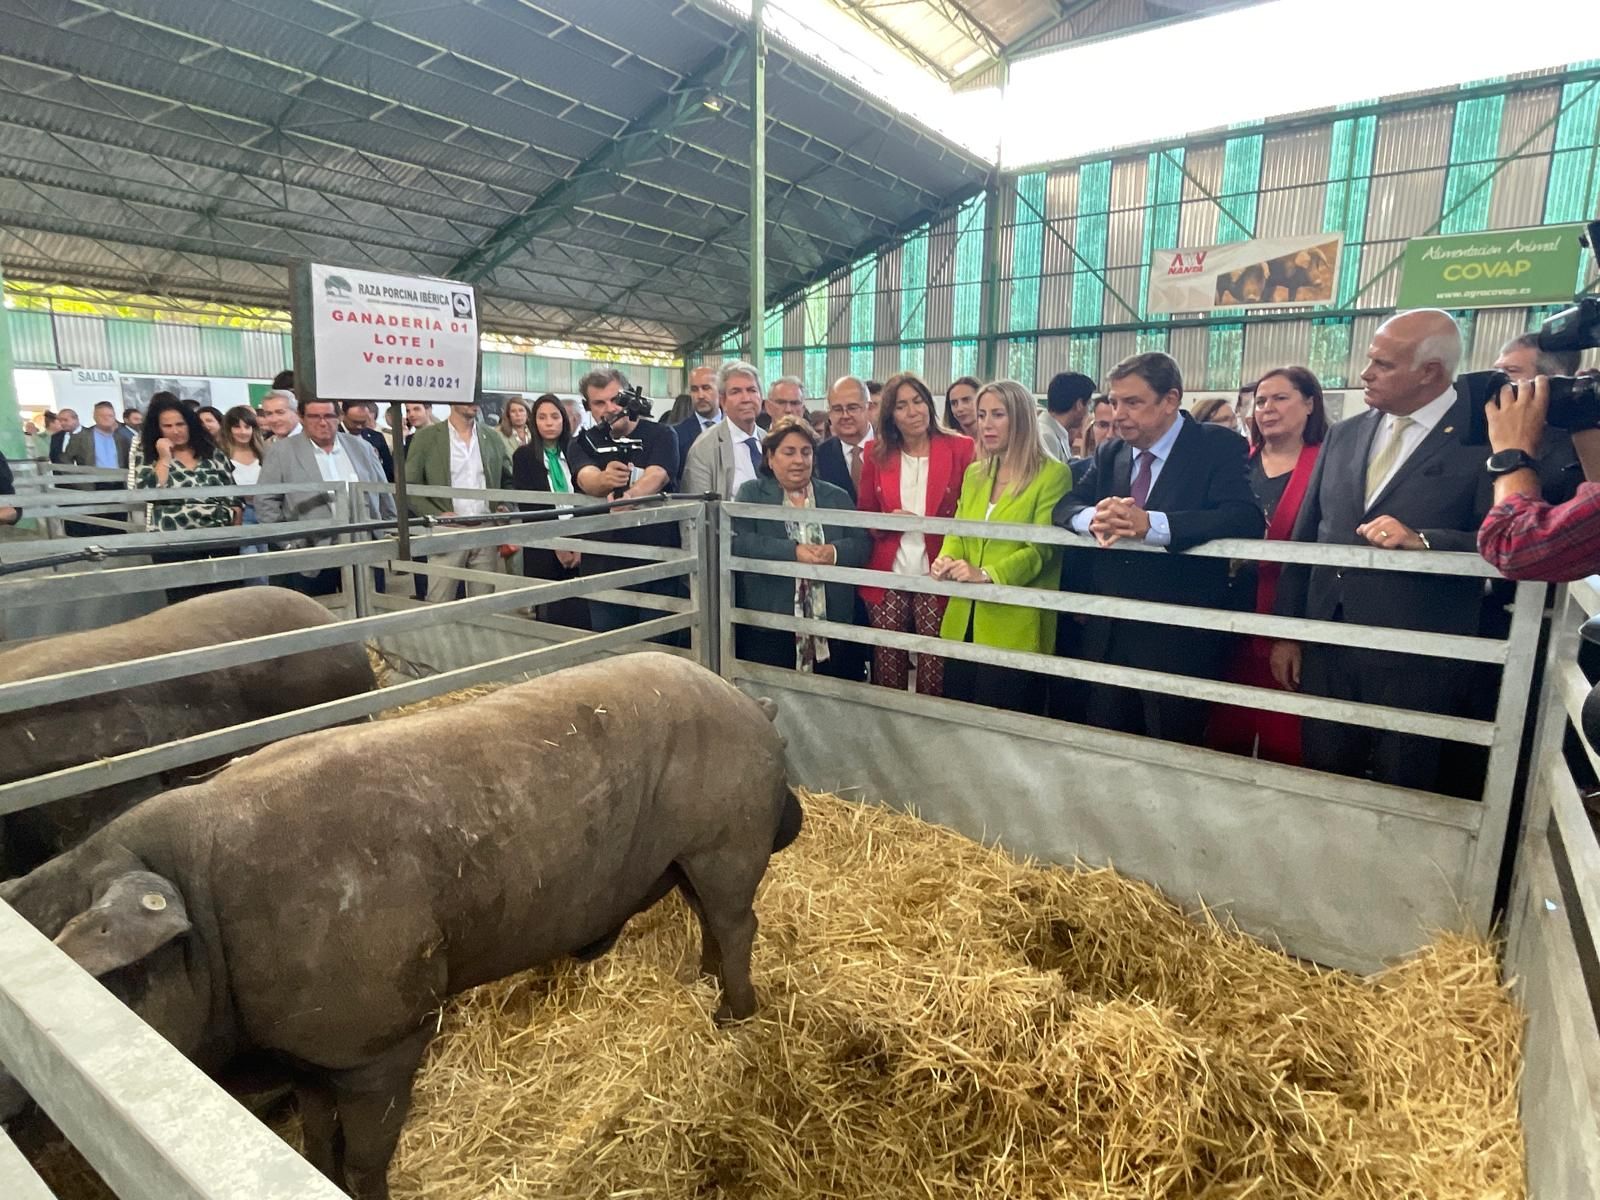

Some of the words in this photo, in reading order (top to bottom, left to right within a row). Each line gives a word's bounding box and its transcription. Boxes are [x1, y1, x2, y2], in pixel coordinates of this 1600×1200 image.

[1507, 235, 1561, 254] Animal
[1443, 259, 1531, 281] COVAP
[358, 283, 382, 297] RAZA
[382, 286, 419, 301] PORCINA
[419, 289, 450, 306] IBÉRICA
[1436, 287, 1531, 299] www.agrocovap.es
[331, 309, 443, 332] GANADERÍA
[450, 321, 469, 333] 01
[374, 333, 421, 348] LOTE
[429, 338, 435, 349] I
[363, 352, 445, 367] Verracos
[78, 370, 115, 383] SALIDA
[384, 374, 461, 389] 21/08/2021
